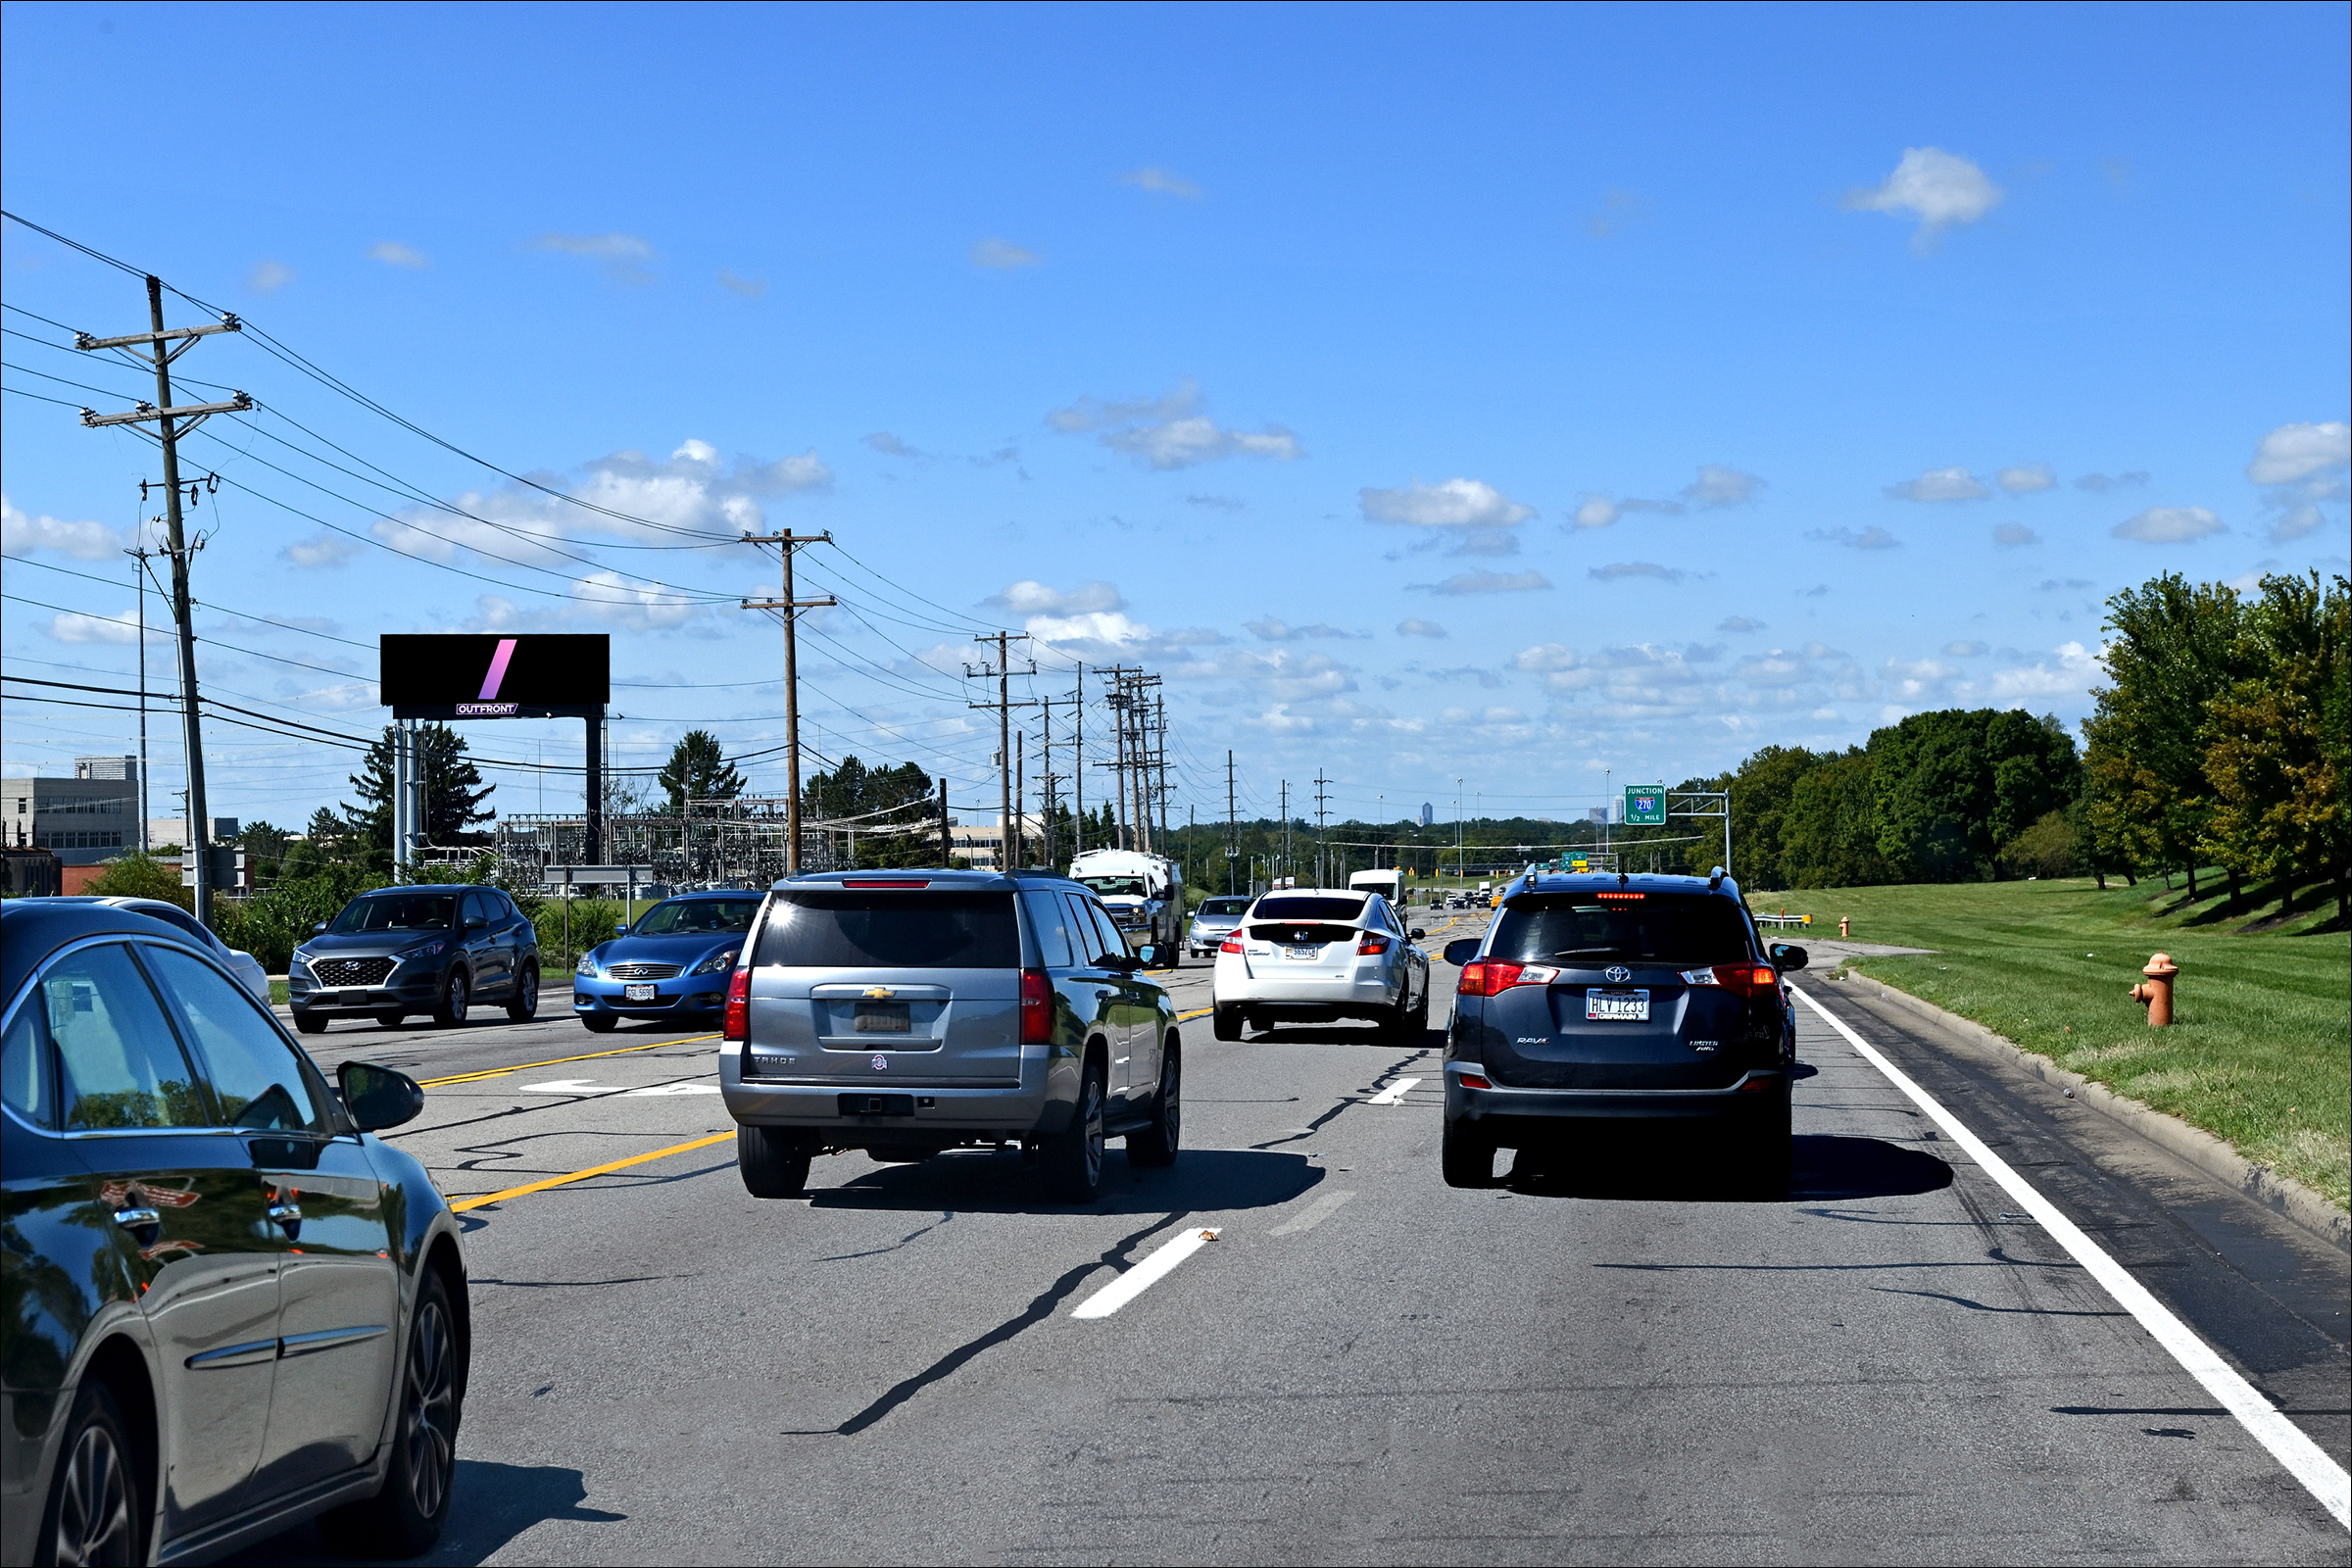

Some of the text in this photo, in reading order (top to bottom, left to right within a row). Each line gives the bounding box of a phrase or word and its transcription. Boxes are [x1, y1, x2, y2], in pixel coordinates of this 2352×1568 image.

[459, 705, 514, 713] OUTFRONT
[1638, 800, 1651, 809] 270
[1630, 813, 1641, 822] 1/2
[1617, 997, 1644, 1012] 1233
[754, 1056, 796, 1065] TAHOE
